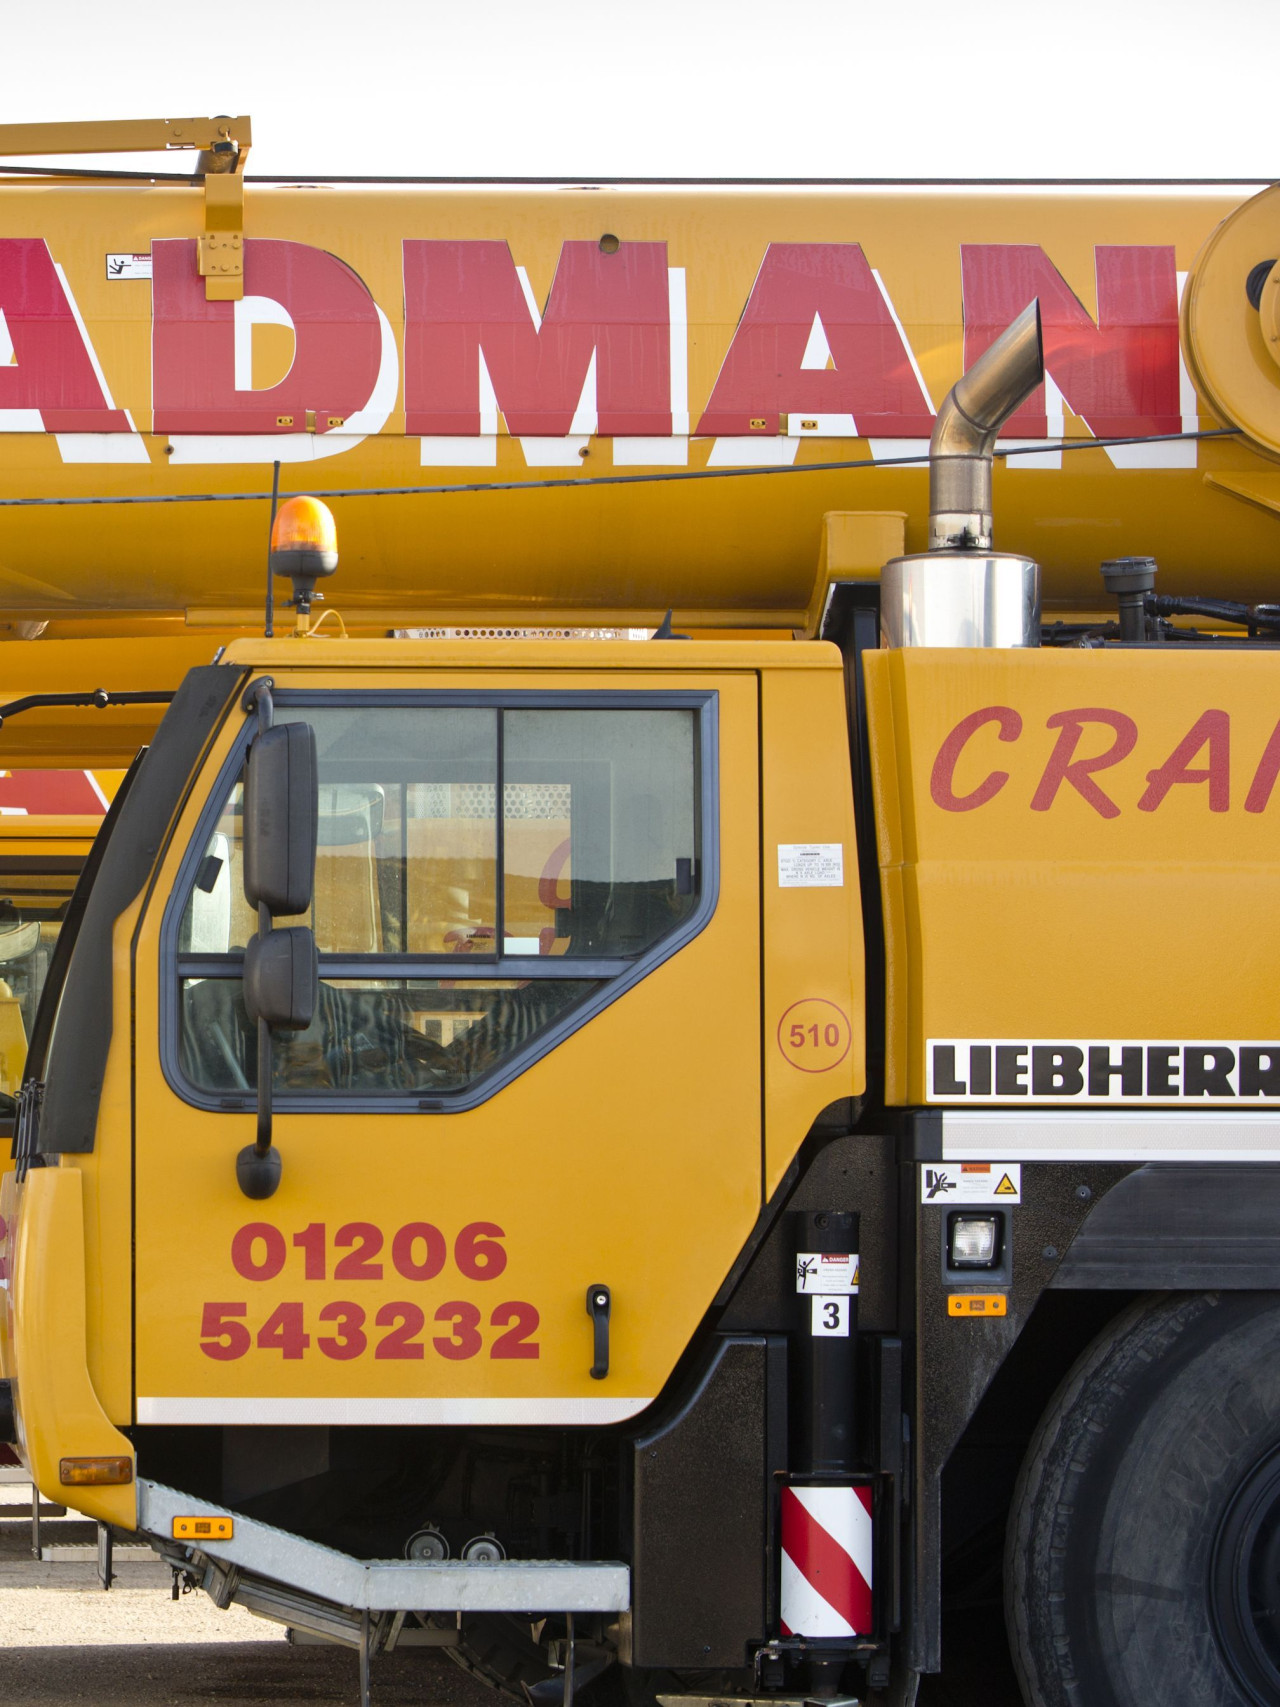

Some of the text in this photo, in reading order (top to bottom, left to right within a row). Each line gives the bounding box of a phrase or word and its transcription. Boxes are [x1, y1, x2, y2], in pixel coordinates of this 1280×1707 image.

[789, 1023, 840, 1048] 510
[933, 1045, 1280, 1096] LIEBHERR
[231, 1221, 507, 1282] 01206
[200, 1300, 540, 1361] 543232
[823, 1302, 840, 1330] 3
